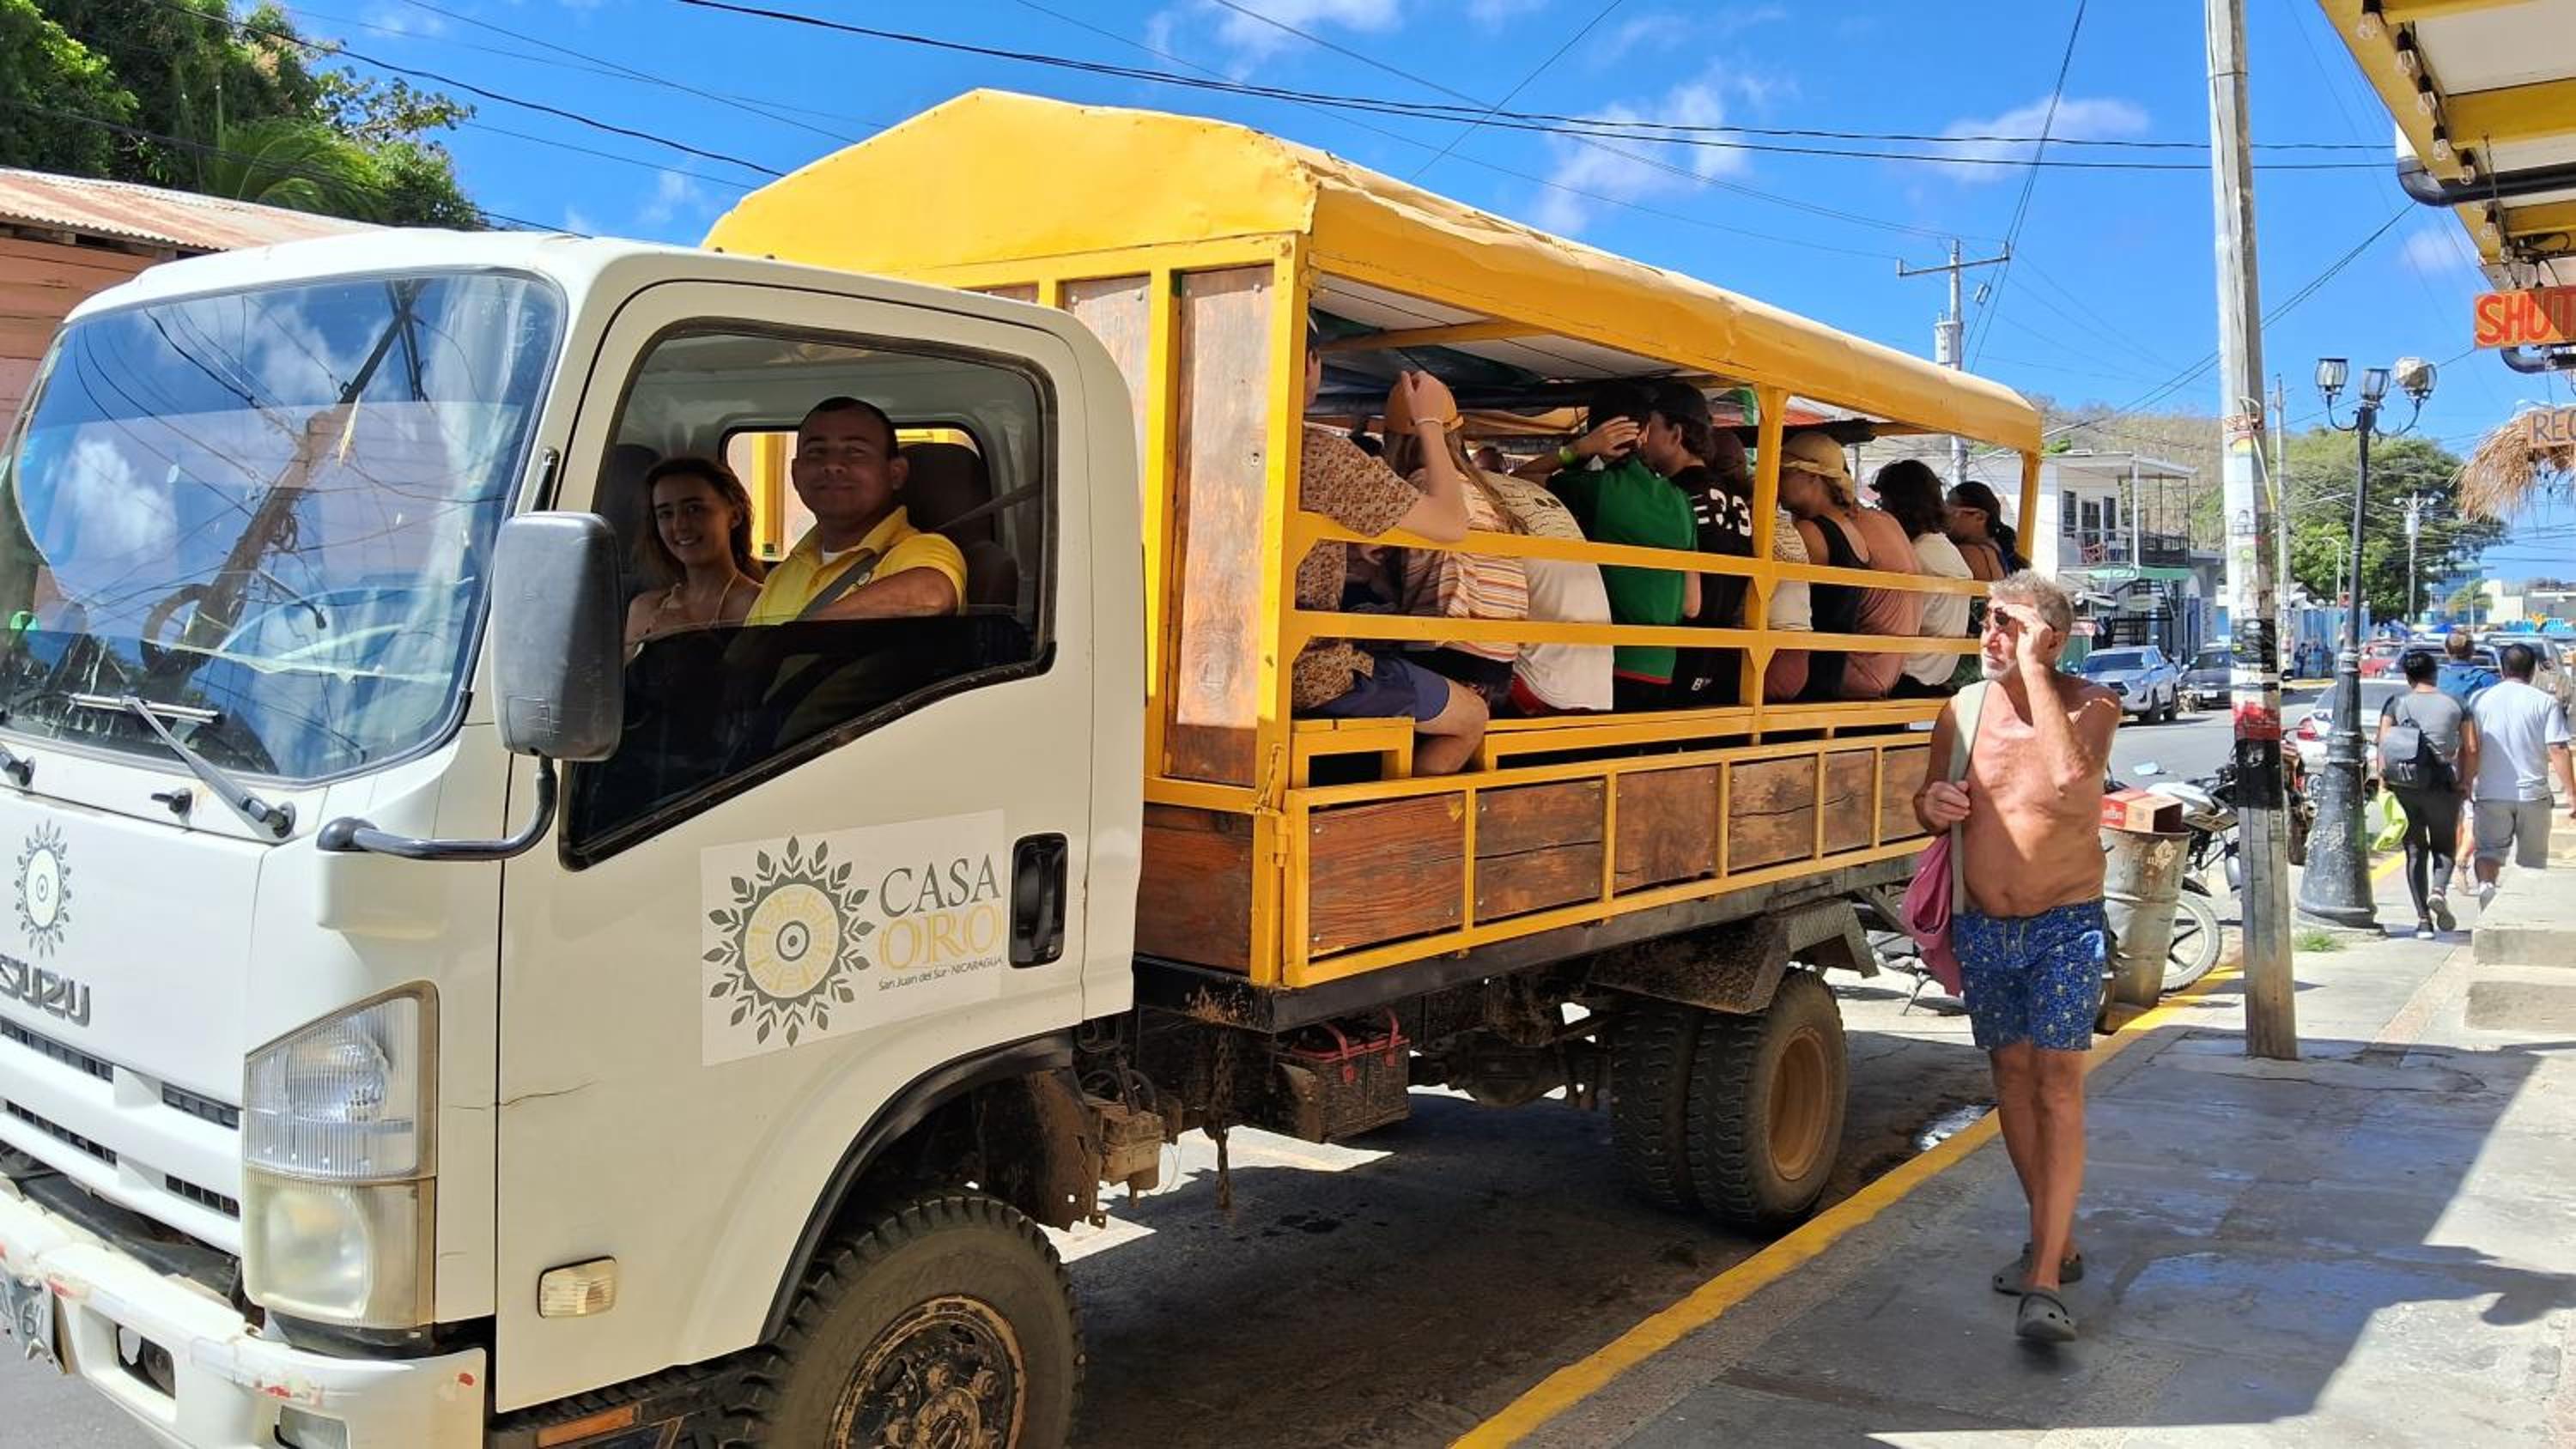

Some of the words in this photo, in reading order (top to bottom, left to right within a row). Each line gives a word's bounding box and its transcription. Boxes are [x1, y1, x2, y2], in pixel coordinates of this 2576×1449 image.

[2477, 288, 2576, 343] SHUT
[879, 853, 1002, 918] CASA
[879, 904, 1003, 970] ORO
[879, 977, 896, 991] San
[897, 975, 918, 987] Juan
[919, 972, 932, 983] del
